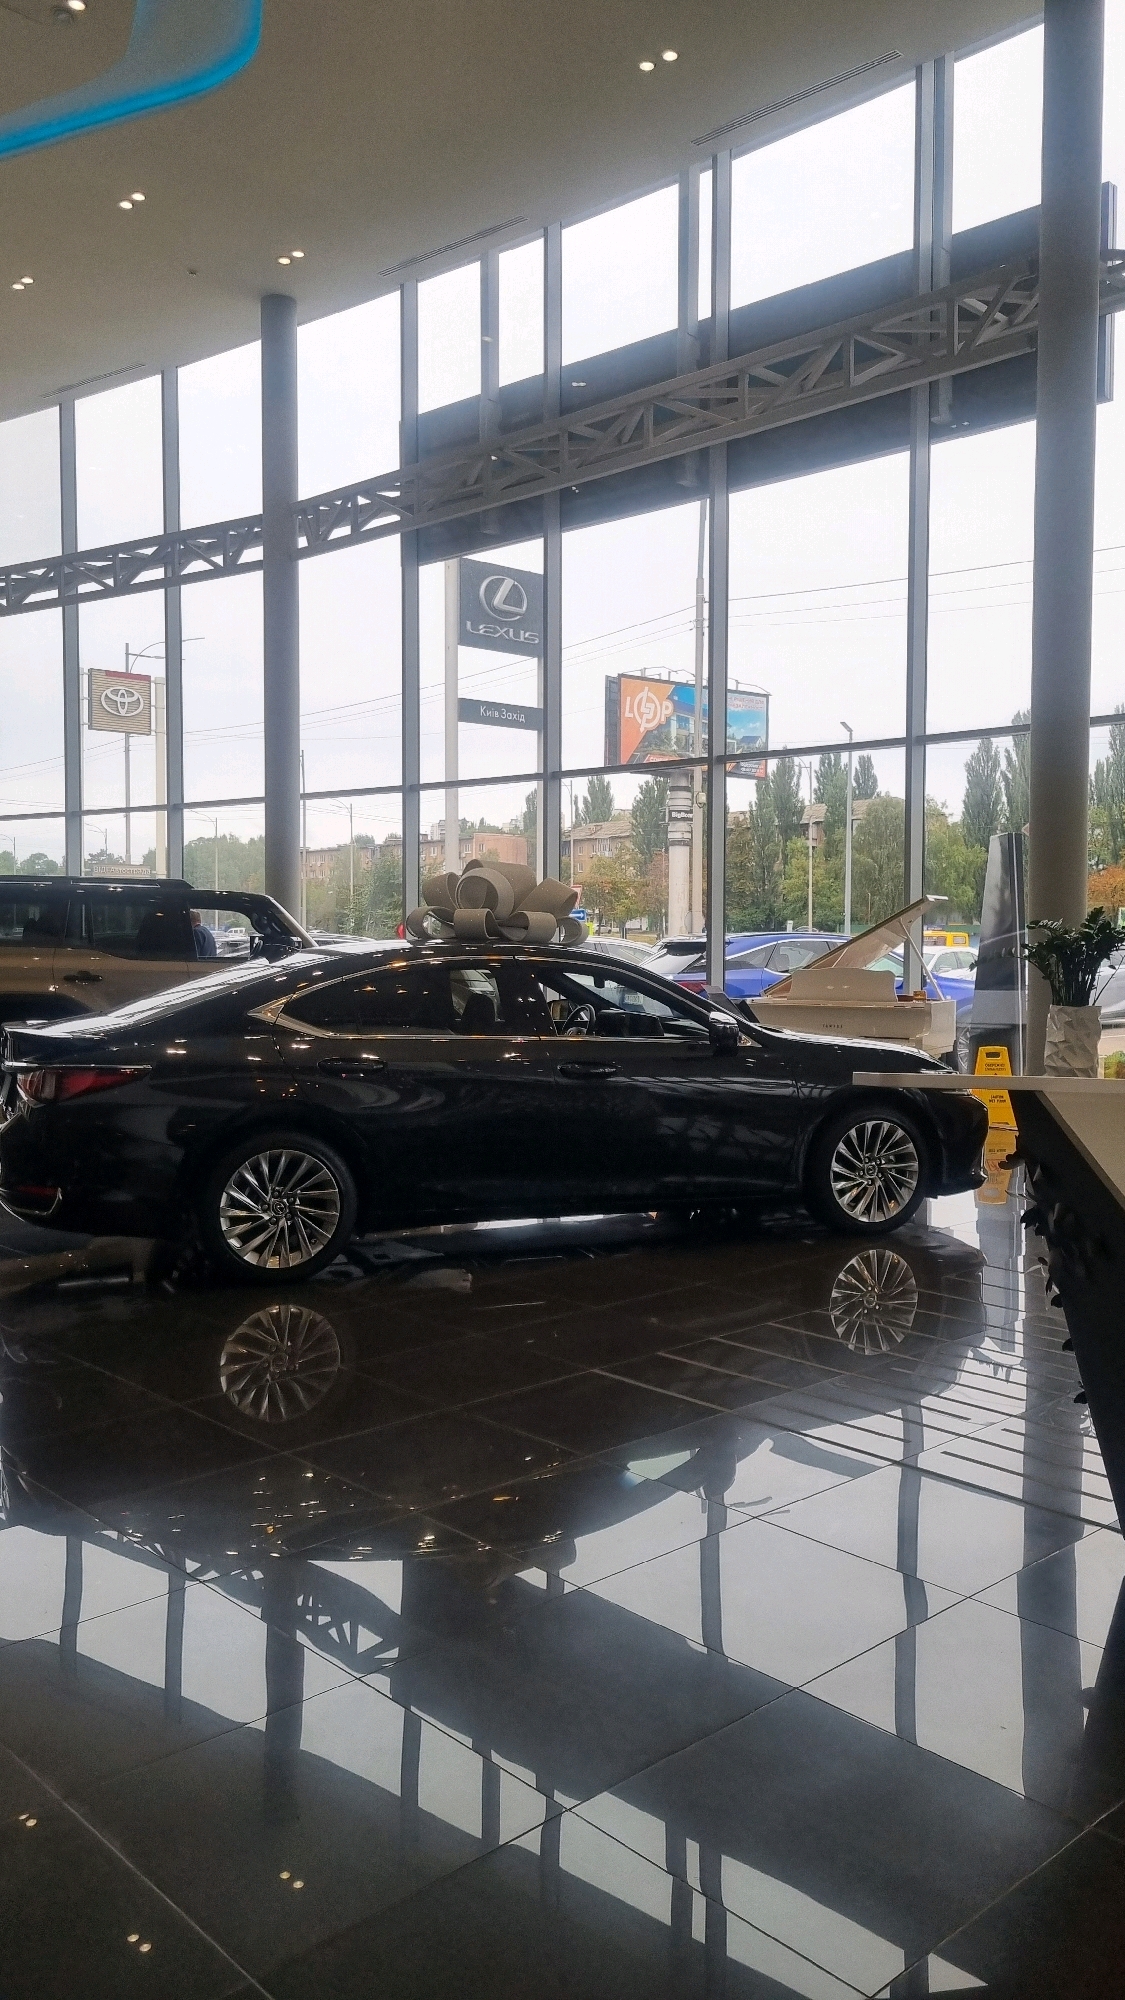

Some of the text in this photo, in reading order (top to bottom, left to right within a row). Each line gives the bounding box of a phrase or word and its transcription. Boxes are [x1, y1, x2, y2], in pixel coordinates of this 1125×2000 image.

[466, 620, 540, 644] LEXUS
[480, 705, 526, 723] Київ Захід
[671, 811, 694, 819] BigBoar
